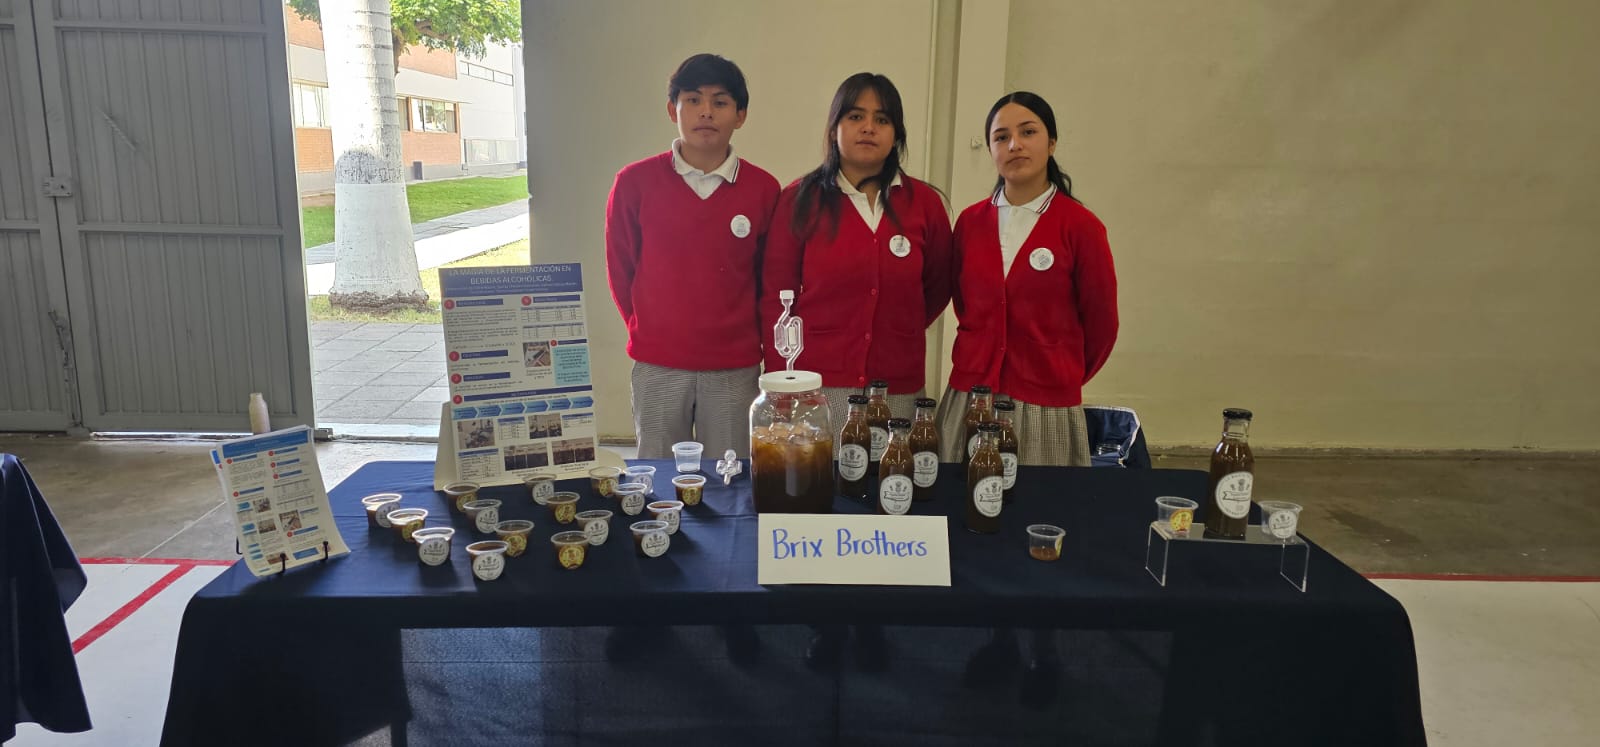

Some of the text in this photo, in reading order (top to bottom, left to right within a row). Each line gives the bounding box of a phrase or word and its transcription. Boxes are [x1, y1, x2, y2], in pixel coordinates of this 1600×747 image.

[507, 265, 561, 273] FERMENTACIÓN
[471, 274, 552, 285] BEBIDAS ALCOHÓLICAS
[772, 528, 928, 559] Brix Brothers
